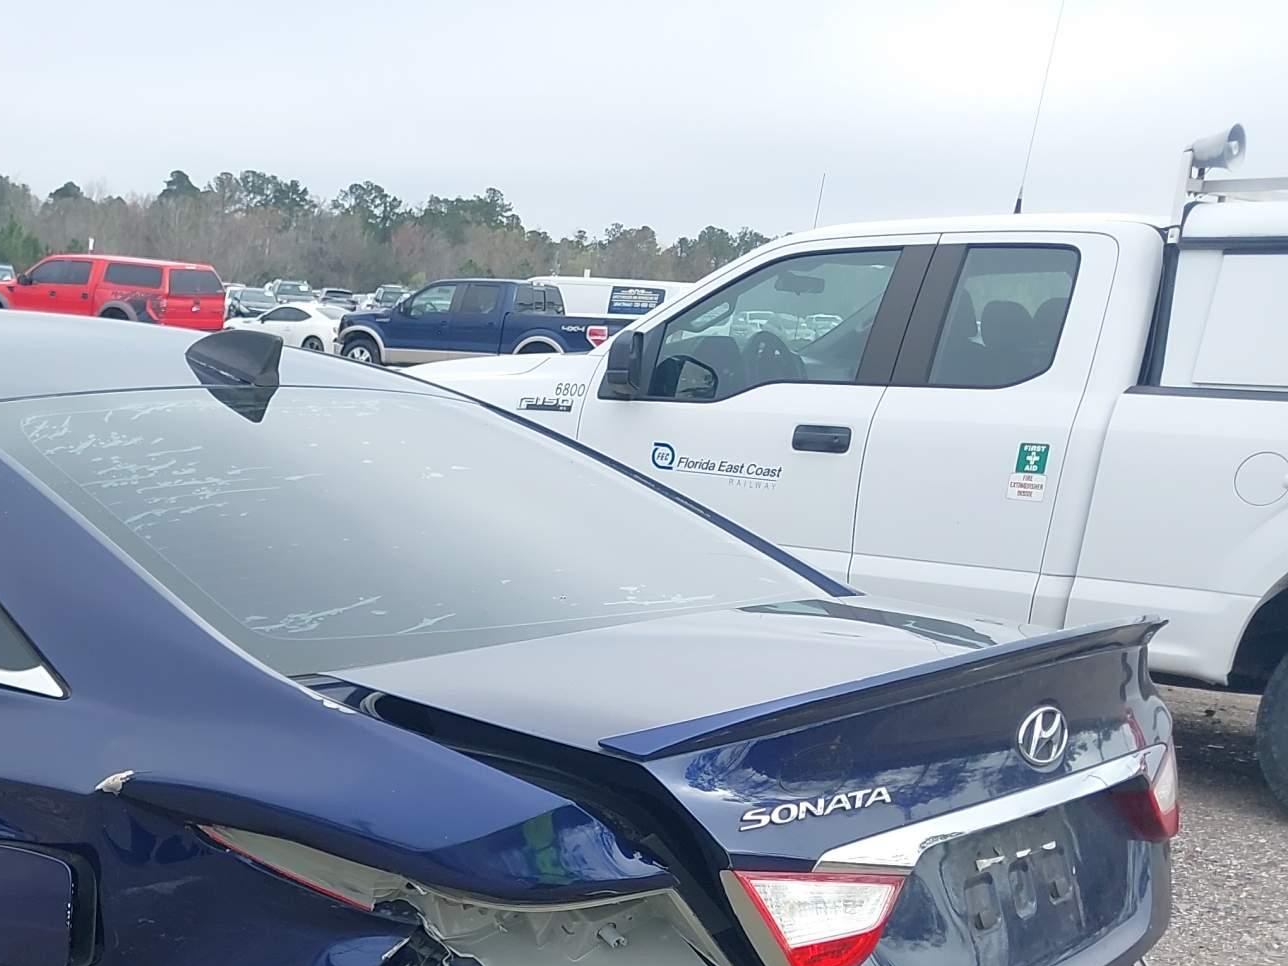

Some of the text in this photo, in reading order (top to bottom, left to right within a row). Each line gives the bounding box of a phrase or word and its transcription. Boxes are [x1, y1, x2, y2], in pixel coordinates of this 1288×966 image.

[555, 382, 586, 397] 6800
[656, 451, 671, 461] FEC
[677, 456, 782, 478] Florida East Coast
[728, 479, 778, 490] RAILWAY
[739, 786, 892, 832] SONATA
